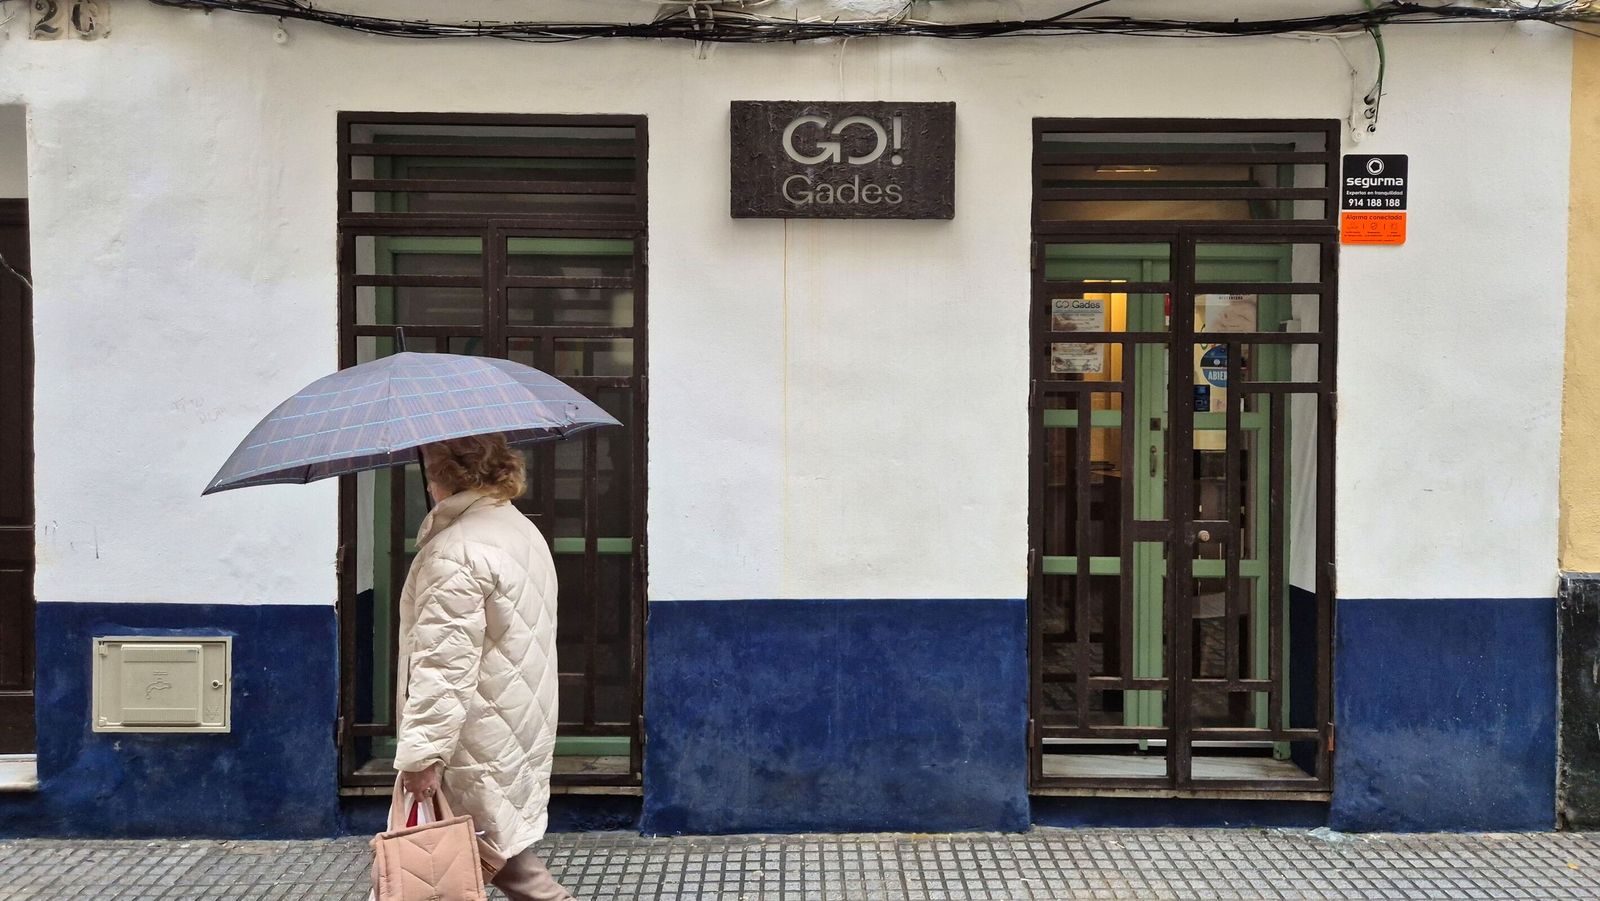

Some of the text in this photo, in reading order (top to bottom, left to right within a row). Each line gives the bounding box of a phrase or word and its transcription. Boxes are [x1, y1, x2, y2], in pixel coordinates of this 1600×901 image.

[782, 115, 903, 166] GO!
[1346, 177, 1404, 188] segurma
[782, 174, 903, 204] Gades
[1348, 198, 1400, 207] 914 188 188
[1072, 300, 1101, 309] Gades
